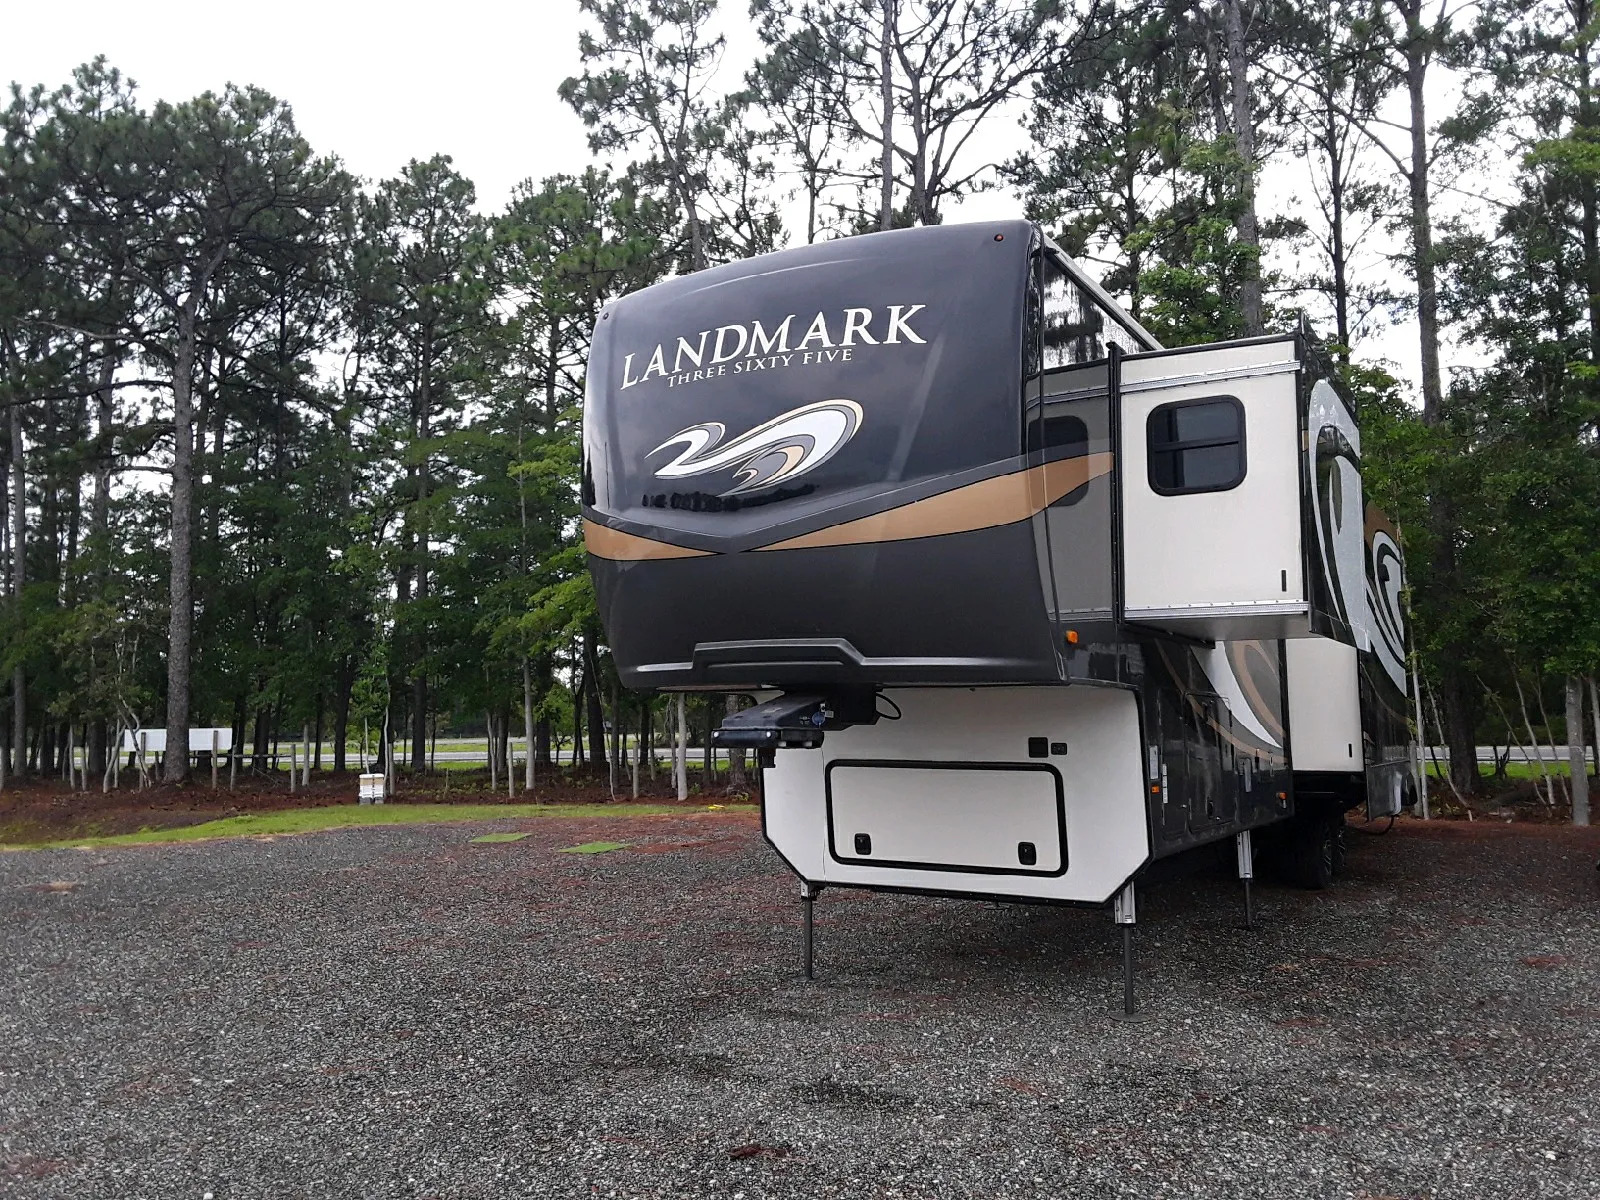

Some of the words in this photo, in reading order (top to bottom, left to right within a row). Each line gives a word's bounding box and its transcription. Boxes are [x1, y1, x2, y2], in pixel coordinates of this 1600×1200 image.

[620, 304, 927, 390] LANDMARK
[667, 365, 726, 388] THREE
[733, 353, 795, 374] SIXTY
[802, 348, 853, 366] FIVE
